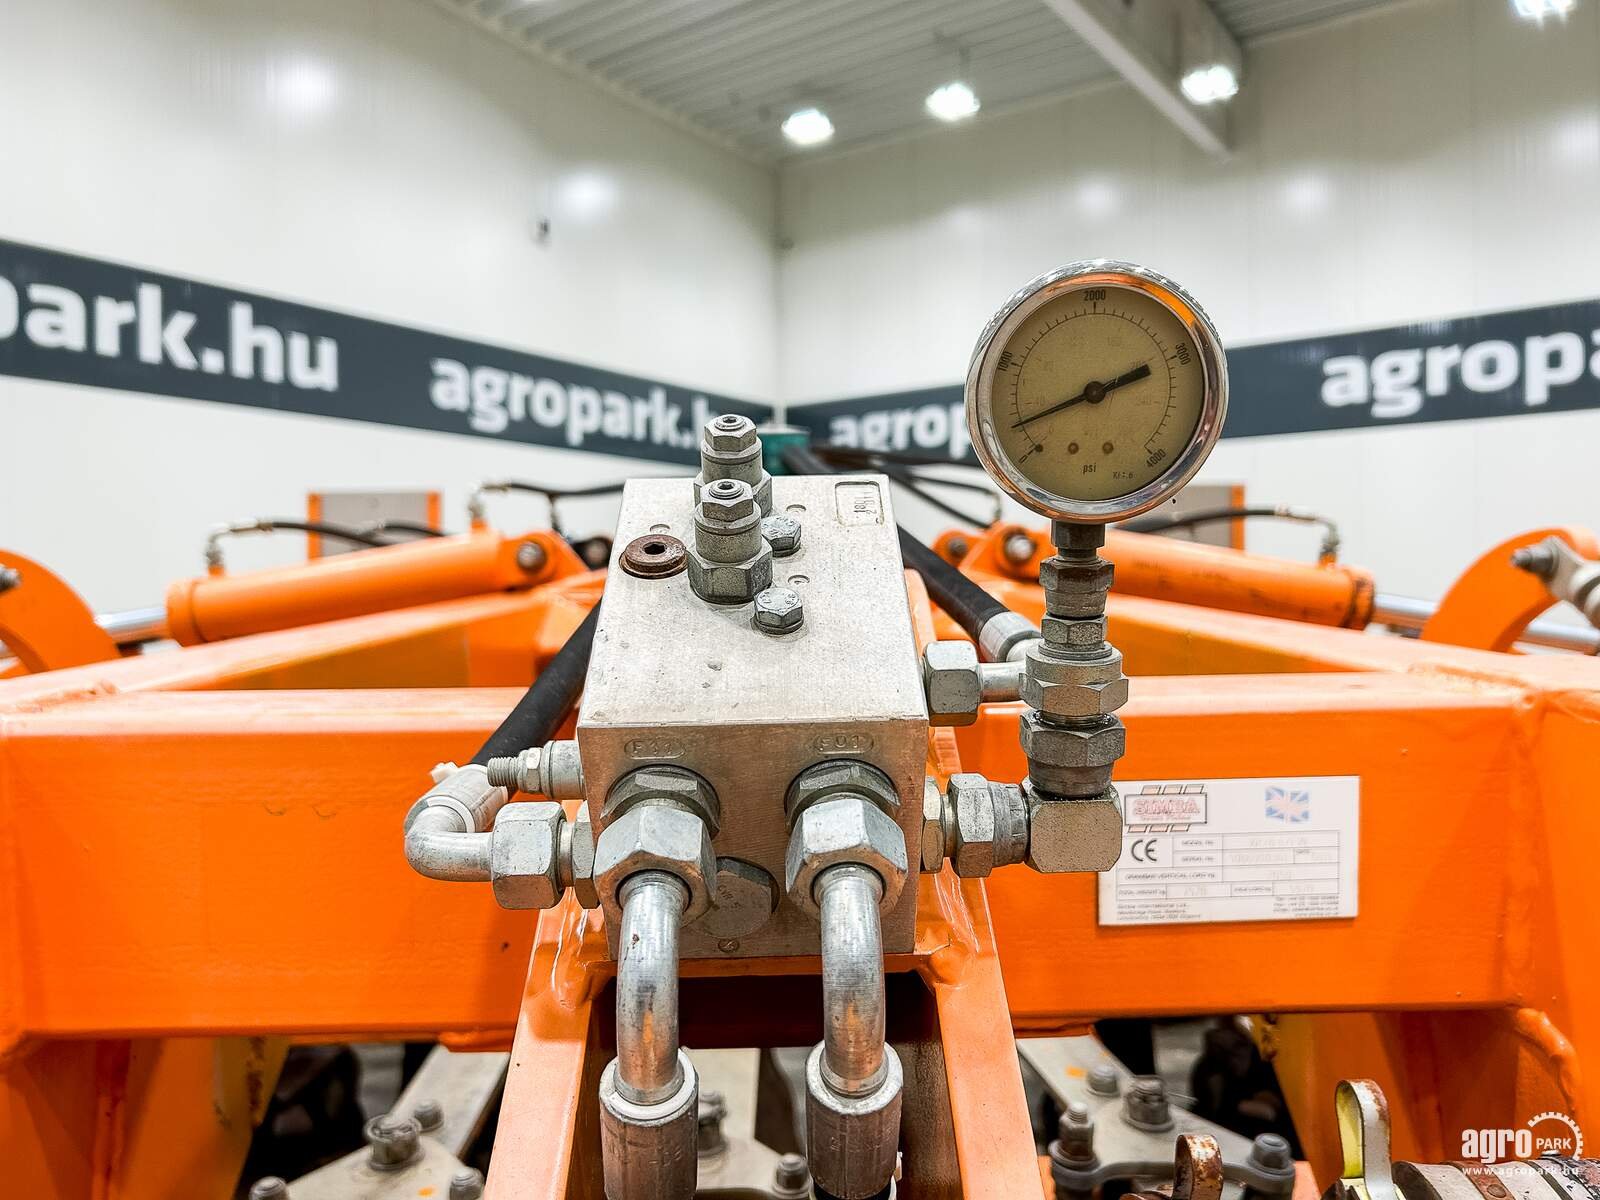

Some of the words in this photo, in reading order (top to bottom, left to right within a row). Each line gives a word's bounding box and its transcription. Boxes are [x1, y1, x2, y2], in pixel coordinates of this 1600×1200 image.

[1084, 289, 1106, 301] 2000
[0, 275, 339, 392] ark.hu
[997, 351, 1012, 371] 1000
[1175, 342, 1191, 366] 3000
[1320, 328, 1600, 418] agrop
[1146, 448, 1166, 468] 4000
[1082, 462, 1097, 475] psi
